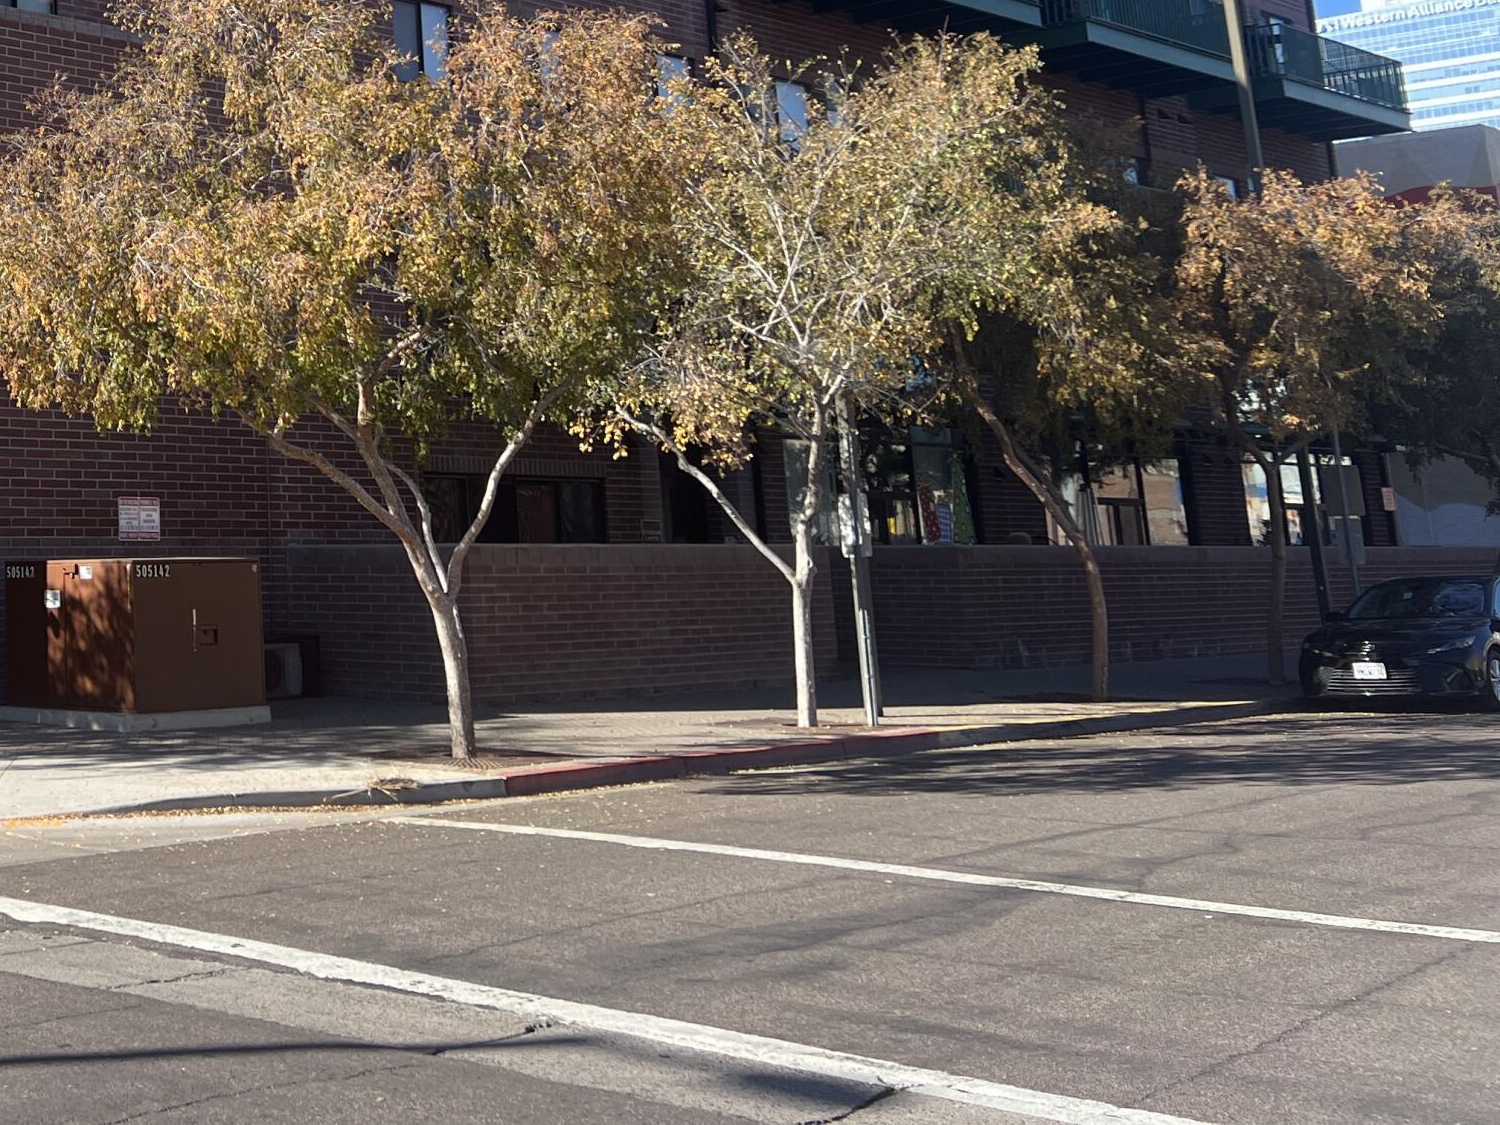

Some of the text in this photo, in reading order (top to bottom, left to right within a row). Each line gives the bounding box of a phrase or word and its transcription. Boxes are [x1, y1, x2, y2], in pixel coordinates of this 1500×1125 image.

[1339, 9, 1409, 30] Western
[6, 565, 36, 579] 505142
[136, 564, 171, 578] 505142
